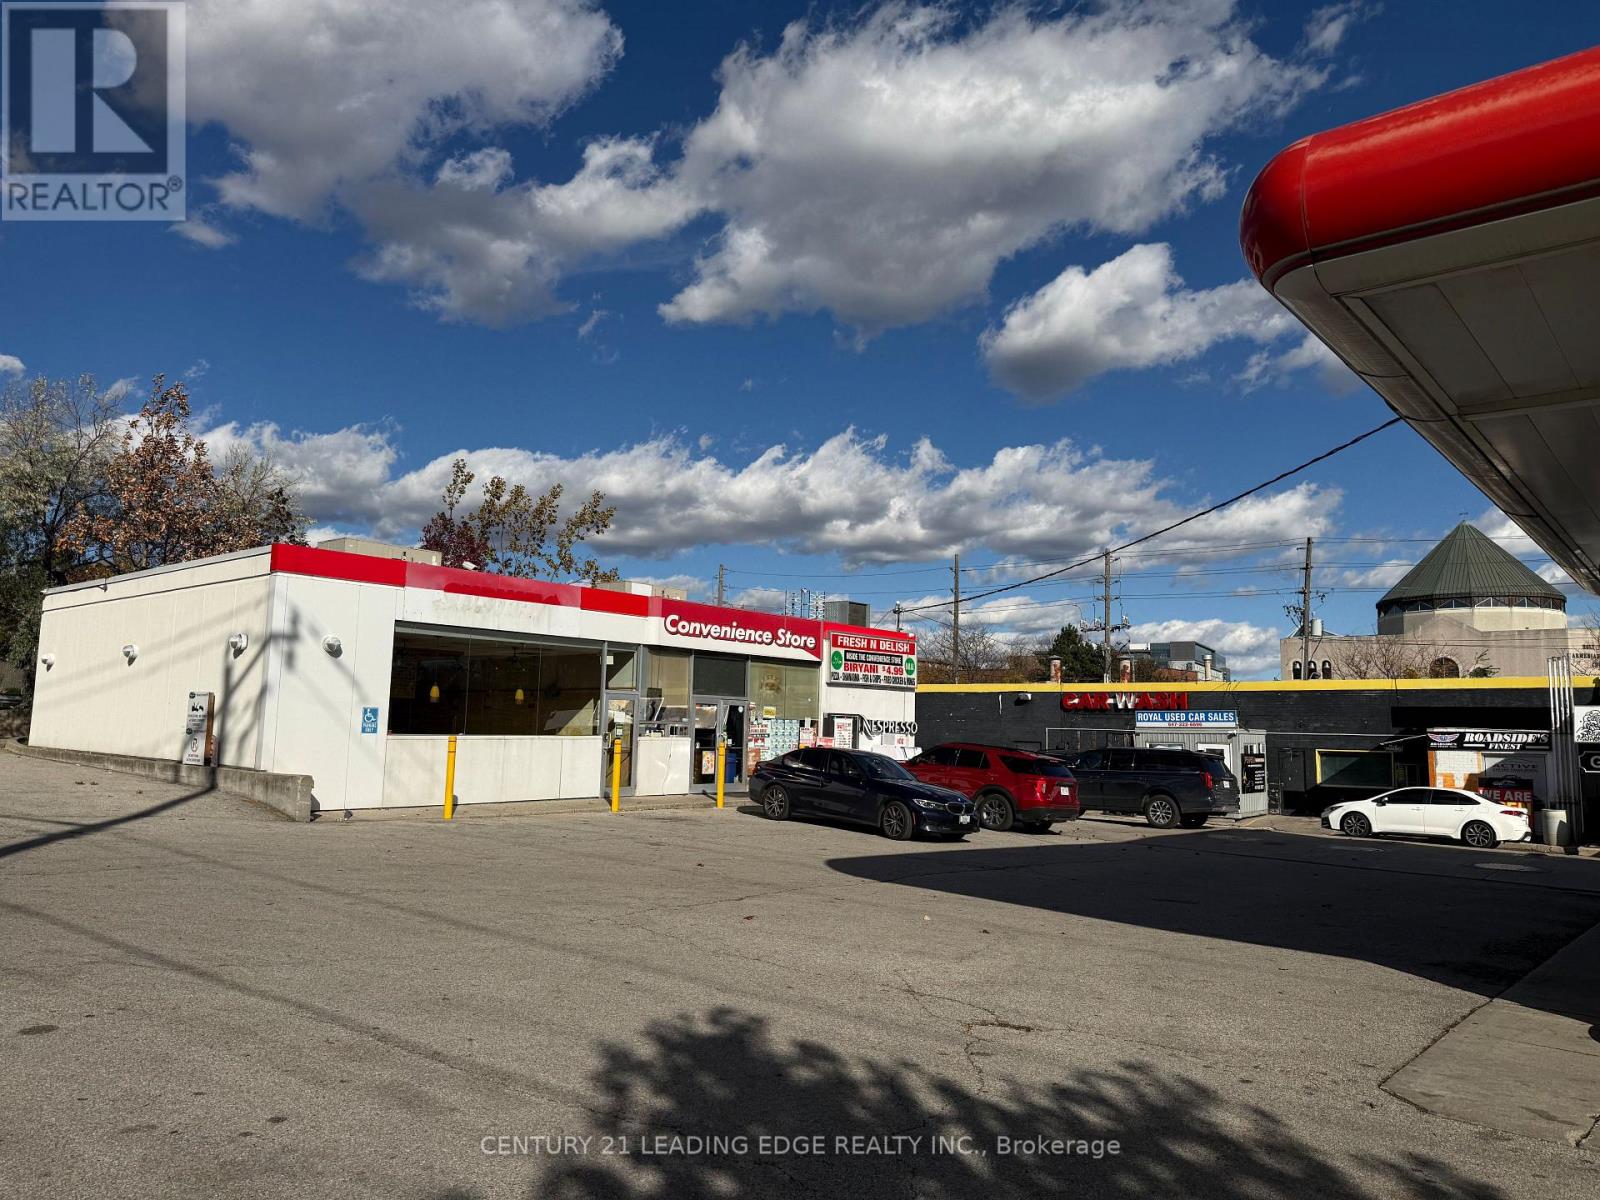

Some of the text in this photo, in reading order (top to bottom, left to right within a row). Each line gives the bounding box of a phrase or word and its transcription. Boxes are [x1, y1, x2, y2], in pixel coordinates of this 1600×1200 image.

[664, 614, 816, 648] Convenience Store
[838, 636, 910, 652] FRESH N DELISH
[844, 663, 878, 673] BIRYANI
[882, 665, 904, 675] $4.99
[1138, 712, 1234, 721] ROYAL USED CAR SALES
[862, 717, 918, 737] NESPRESSO
[1463, 733, 1549, 743] ROADSIDE'S
[1504, 790, 1533, 801] ARE
